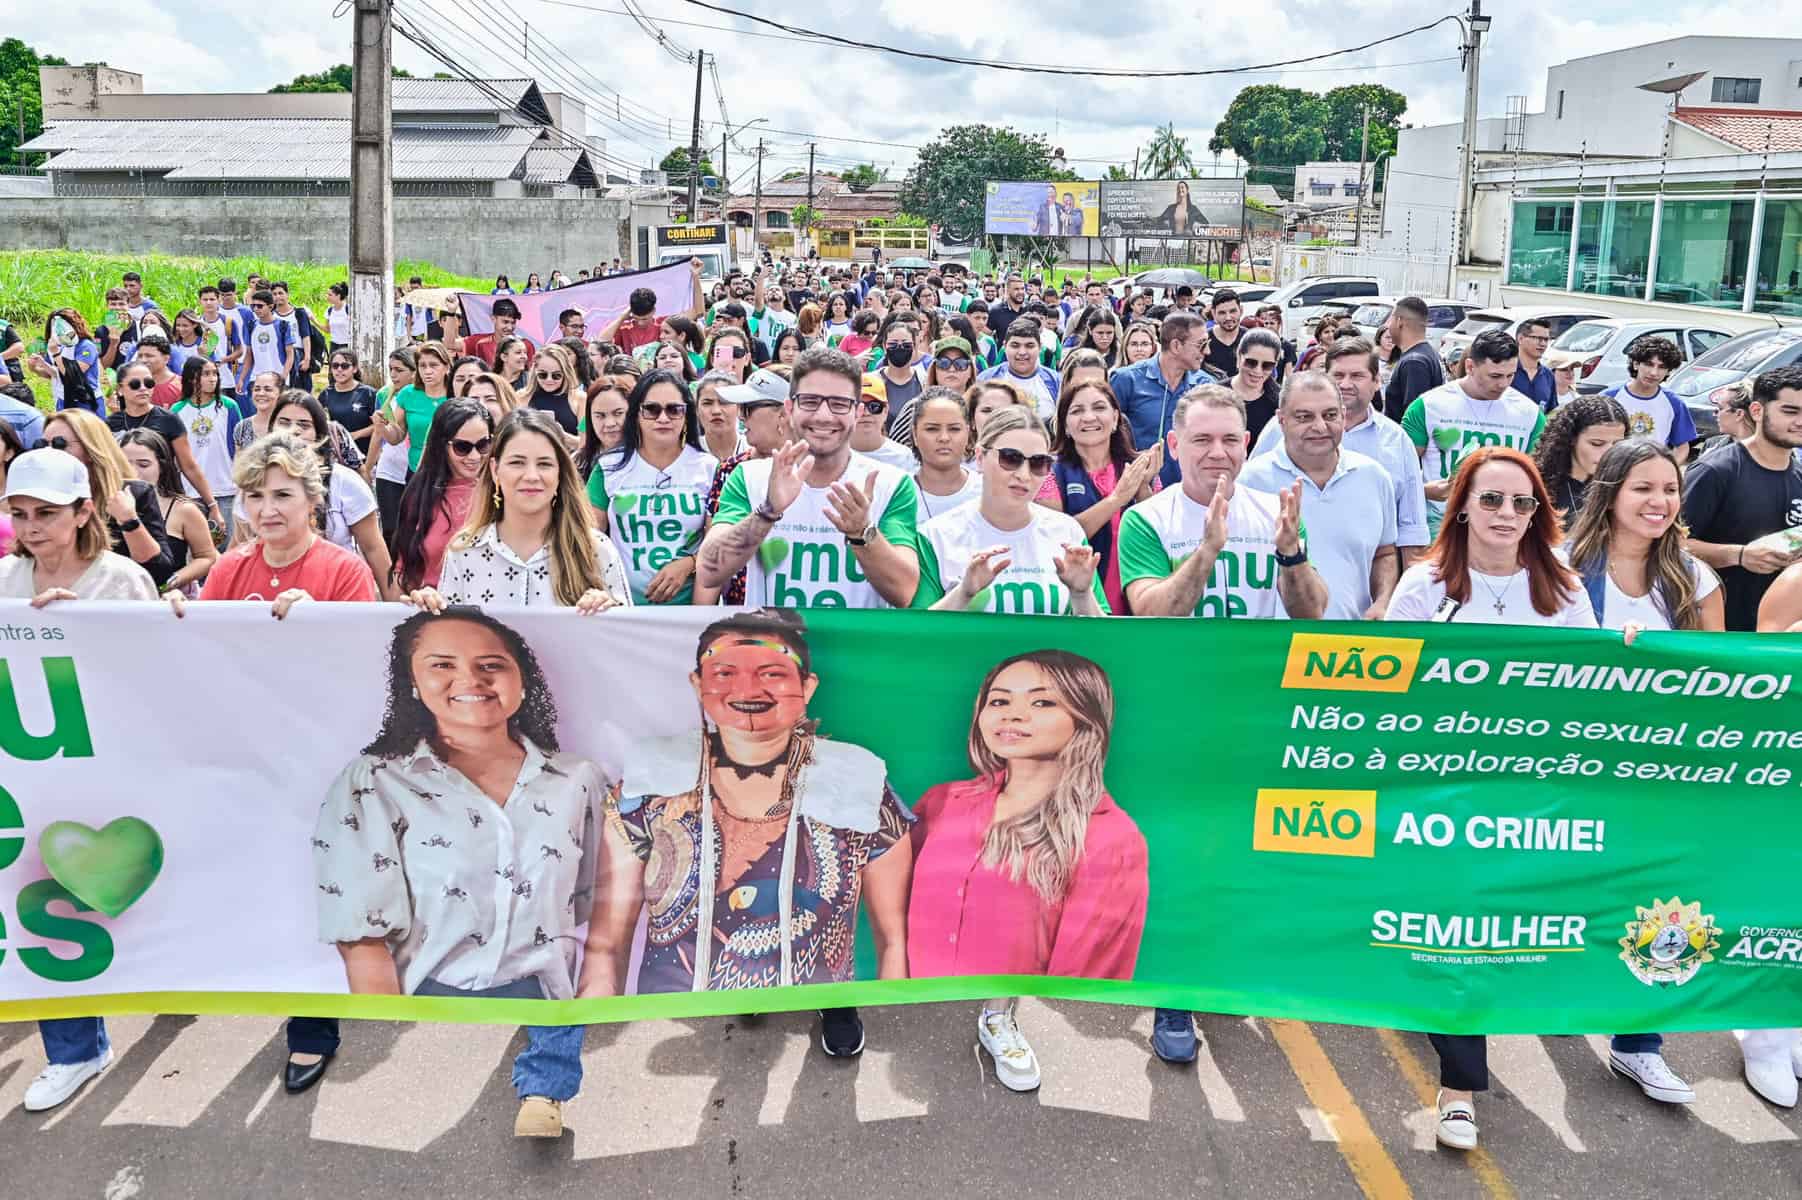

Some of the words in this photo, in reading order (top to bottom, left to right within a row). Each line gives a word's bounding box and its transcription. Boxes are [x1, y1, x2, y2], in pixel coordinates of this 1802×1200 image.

[1194, 227, 1240, 236] UNINORTE
[640, 493, 701, 516] mu
[615, 514, 683, 543] lhe
[40, 626, 65, 640] as
[1304, 648, 1402, 680] NÃO
[1421, 658, 1490, 684] AO
[1498, 661, 1792, 700] FEMINICÍDIO!
[1291, 705, 1365, 730] Não
[1376, 713, 1423, 732] ao
[1433, 711, 1551, 736] abuso
[1560, 720, 1688, 746] sexual
[1696, 725, 1743, 748] de
[1281, 745, 1354, 769] Não
[1365, 748, 1386, 771] à
[1398, 750, 1604, 779] exploração
[1613, 761, 1738, 784] sexual
[1745, 763, 1792, 786] de
[1272, 801, 1361, 840] NÃO
[1392, 812, 1455, 847] AO
[1465, 815, 1605, 852] CRIME!
[1371, 909, 1586, 948] SEMULHER
[1411, 952, 1462, 964] SECRETARIA
[1463, 956, 1473, 964] DE
[1474, 955, 1504, 964] ESTADO
[1504, 955, 1514, 963] DA
[1516, 954, 1547, 963] MULHER
[1726, 936, 1802, 962] ACR
